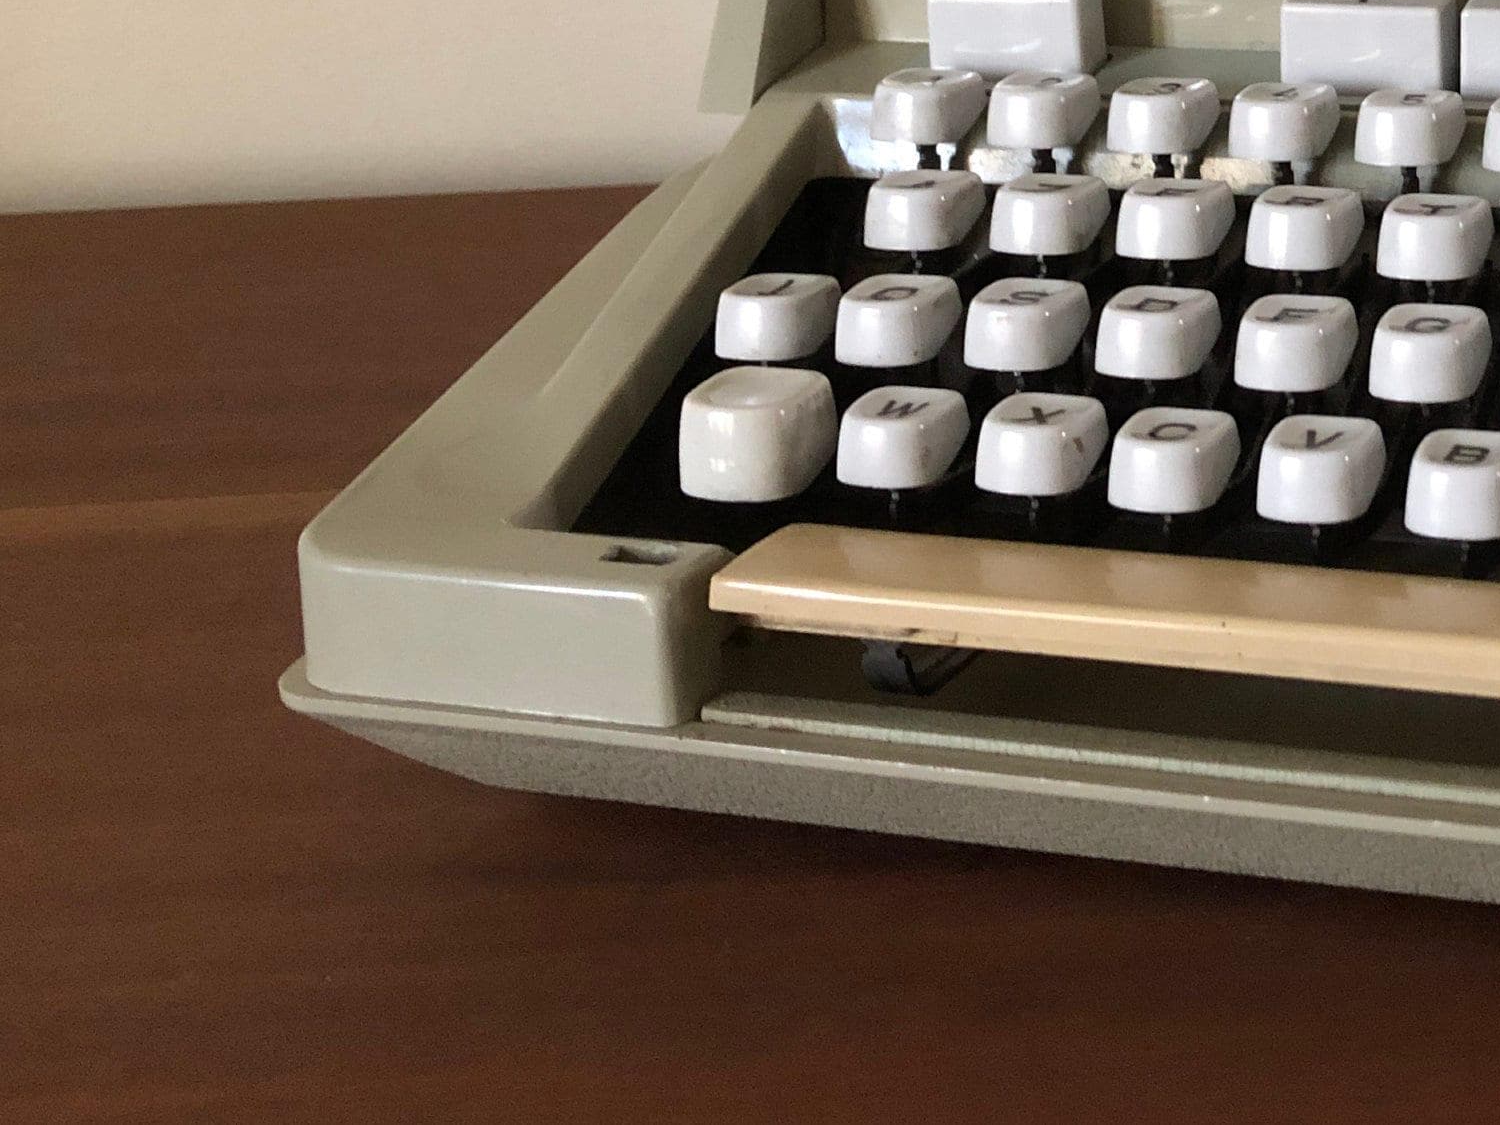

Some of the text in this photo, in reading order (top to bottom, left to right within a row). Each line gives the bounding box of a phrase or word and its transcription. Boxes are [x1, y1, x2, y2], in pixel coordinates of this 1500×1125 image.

[877, 400, 931, 418] W
[1008, 406, 1067, 425] X
[1149, 423, 1198, 441] C
[1306, 429, 1345, 449] V
[1443, 444, 1491, 465] B
